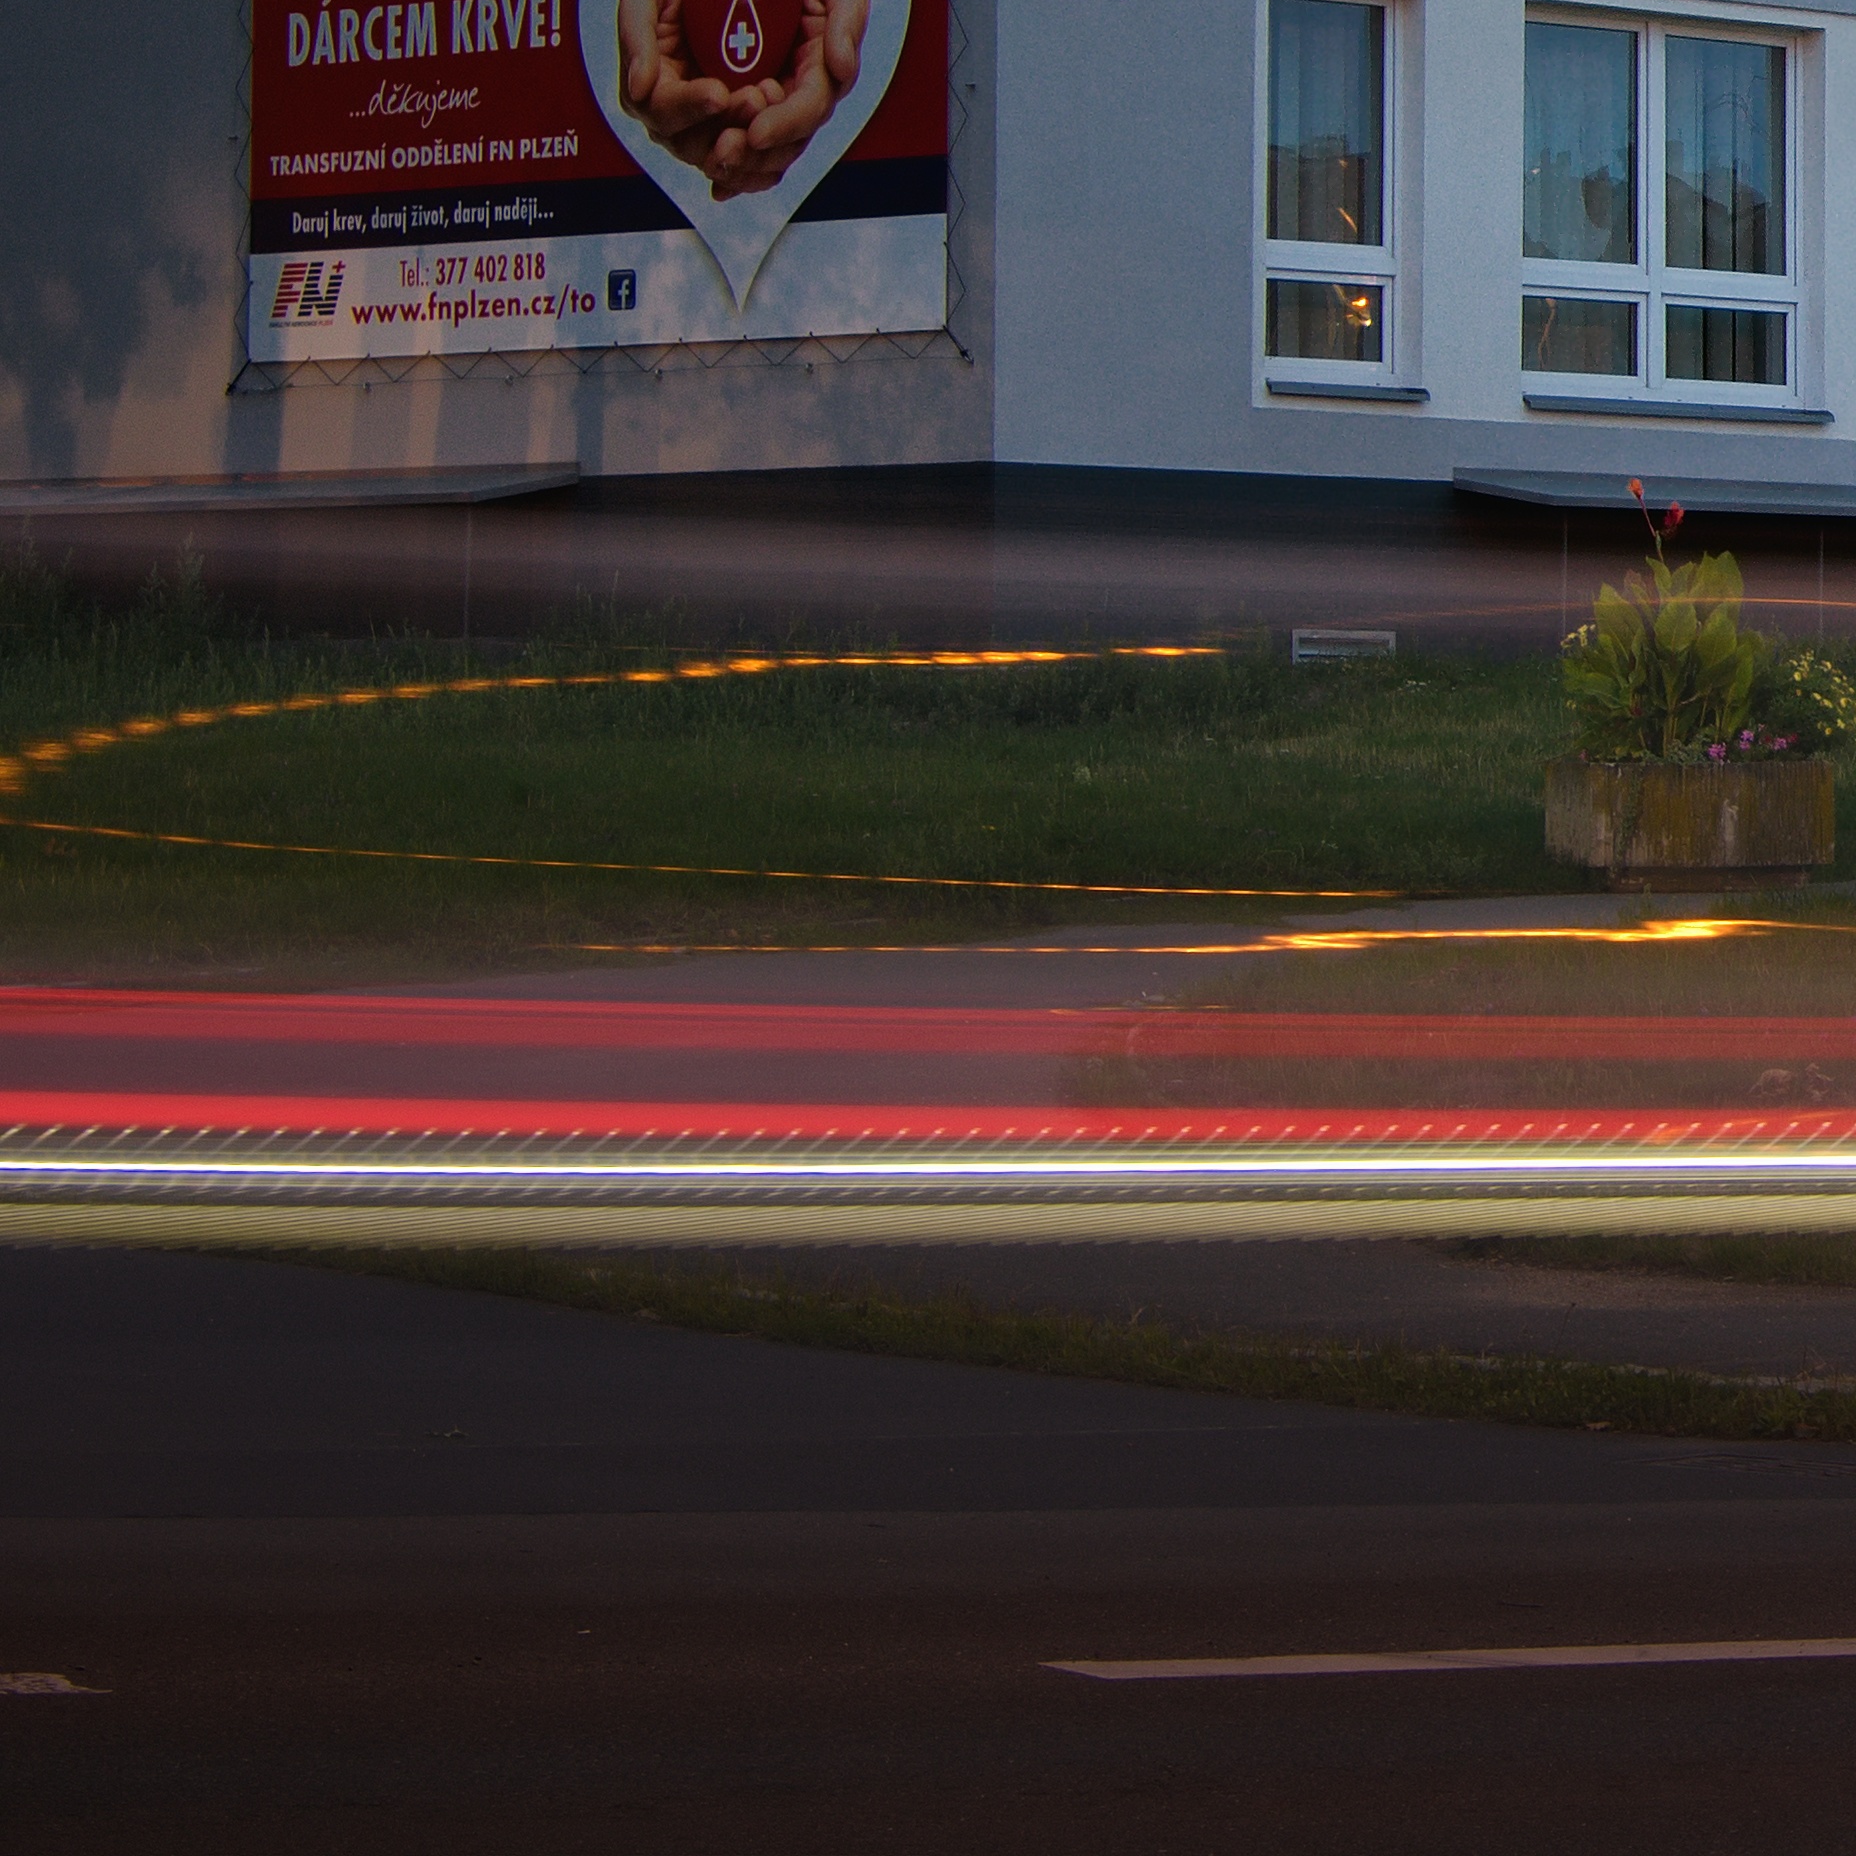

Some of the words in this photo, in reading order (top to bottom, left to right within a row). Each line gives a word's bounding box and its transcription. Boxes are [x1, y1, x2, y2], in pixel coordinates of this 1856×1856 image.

[270, 143, 387, 176] TRANSFUZNÍ
[391, 135, 484, 169] ODDĚLENÍ
[489, 140, 514, 162] FN
[520, 129, 579, 159] PLZEŇ
[292, 211, 329, 239] Daruj
[333, 208, 367, 234] krev,
[371, 206, 408, 234] daruj
[411, 204, 449, 228] život,
[454, 200, 491, 229] daruj
[494, 196, 554, 226] naději...
[400, 259, 429, 288] Tel.:
[436, 257, 470, 286] 377
[474, 254, 508, 282] 402
[513, 252, 546, 282] 818
[351, 282, 596, 328] www.fnplzen.cz/to
